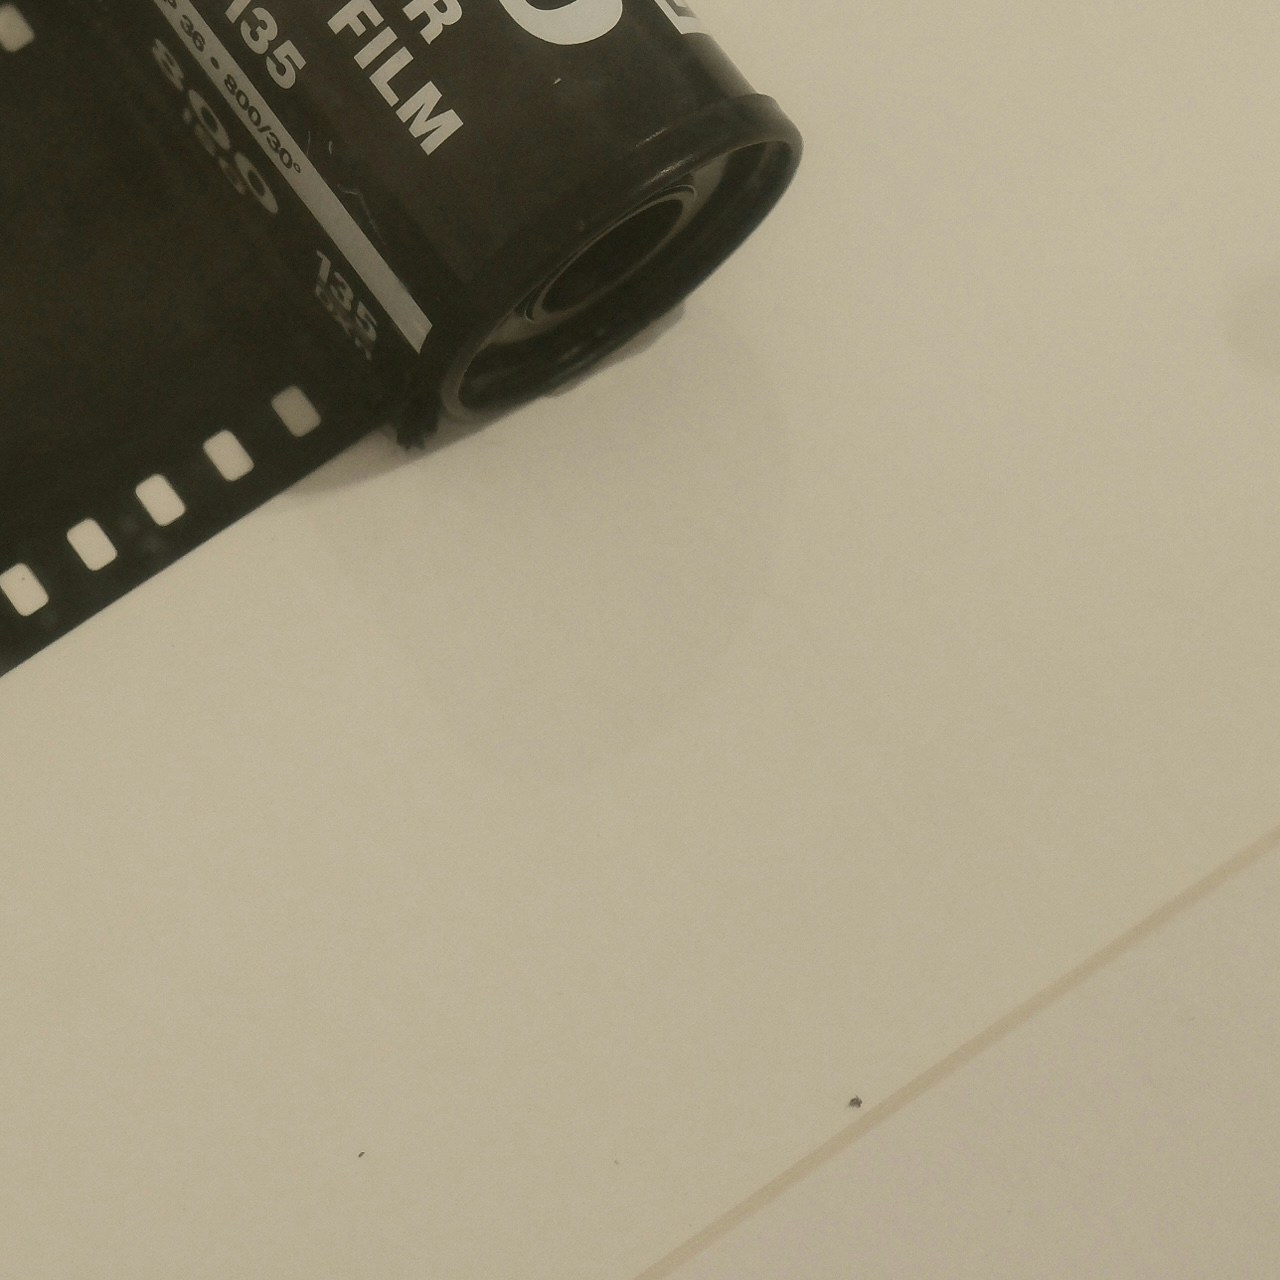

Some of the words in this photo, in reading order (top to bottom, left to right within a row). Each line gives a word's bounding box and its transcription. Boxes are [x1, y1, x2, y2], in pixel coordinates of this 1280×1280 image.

[179, 13, 207, 53] 36
[151, 38, 280, 215] 800
[315, 249, 378, 342] 135
